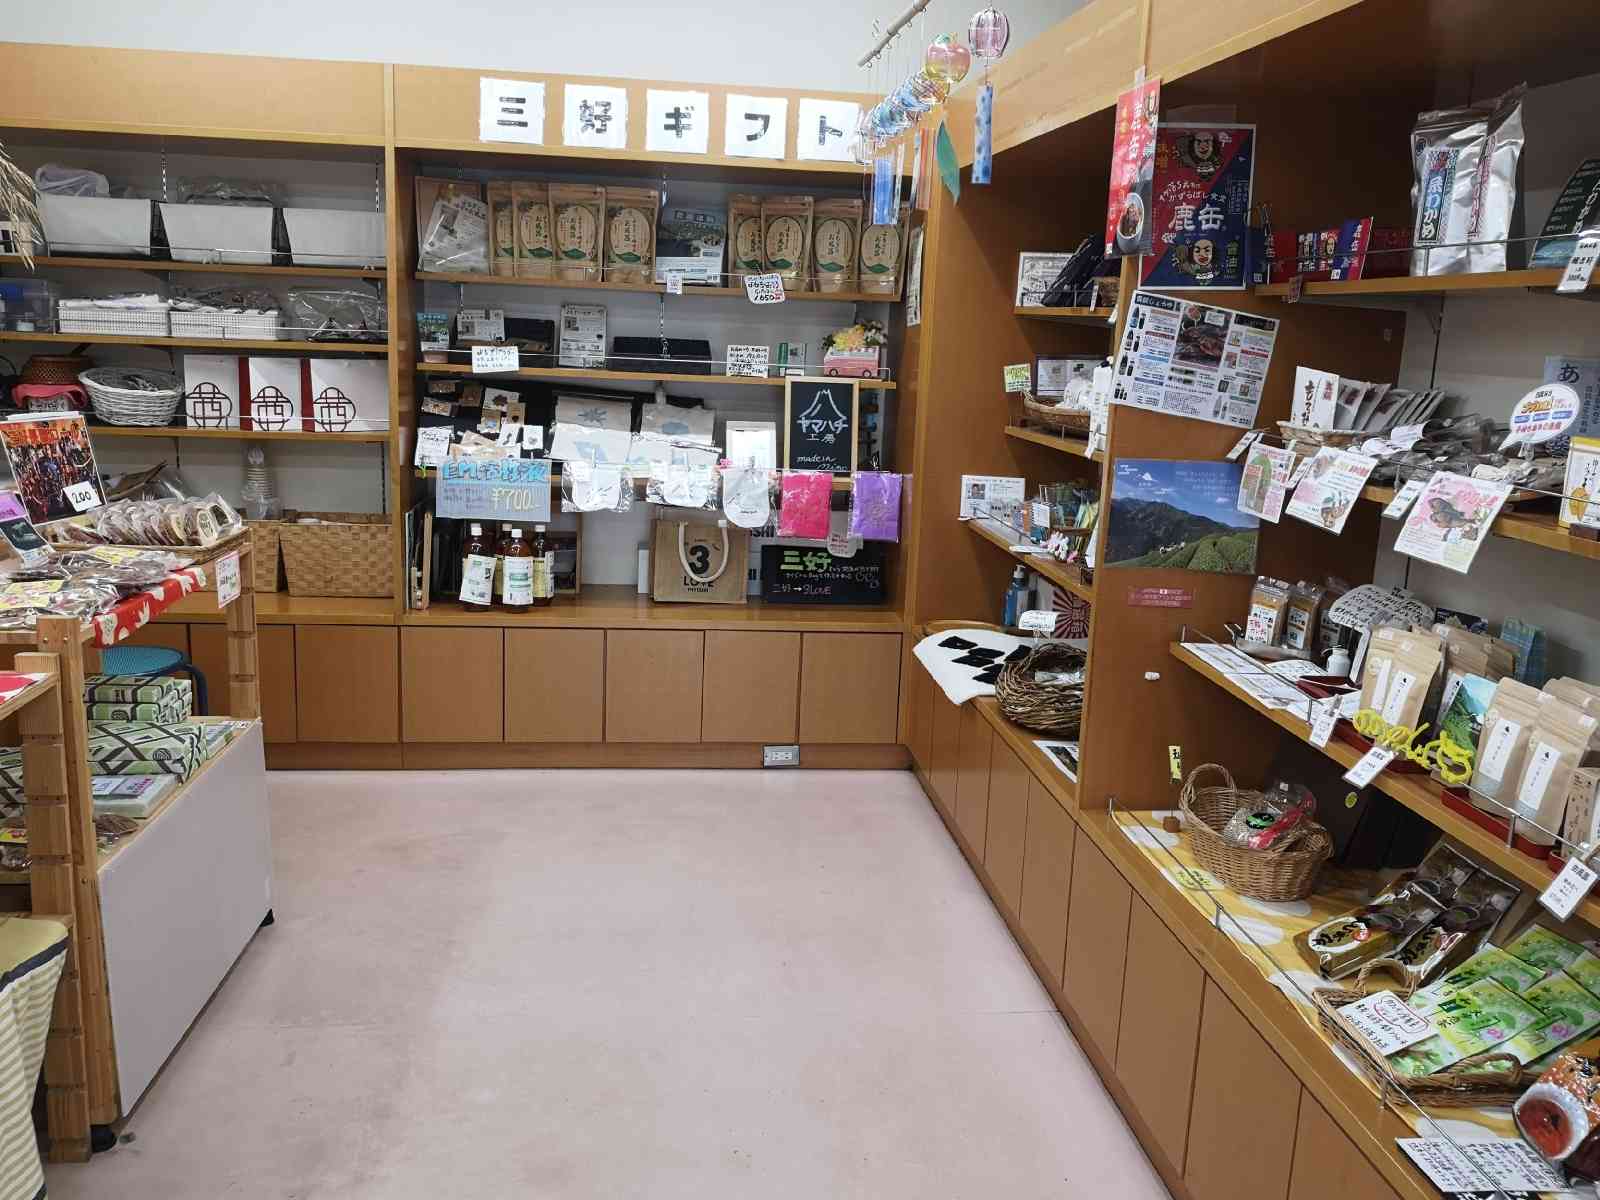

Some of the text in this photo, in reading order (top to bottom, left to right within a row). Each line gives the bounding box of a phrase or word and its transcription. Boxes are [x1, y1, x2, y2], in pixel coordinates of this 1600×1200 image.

[796, 416, 849, 434] ヤマハチ
[689, 544, 710, 575] 3
